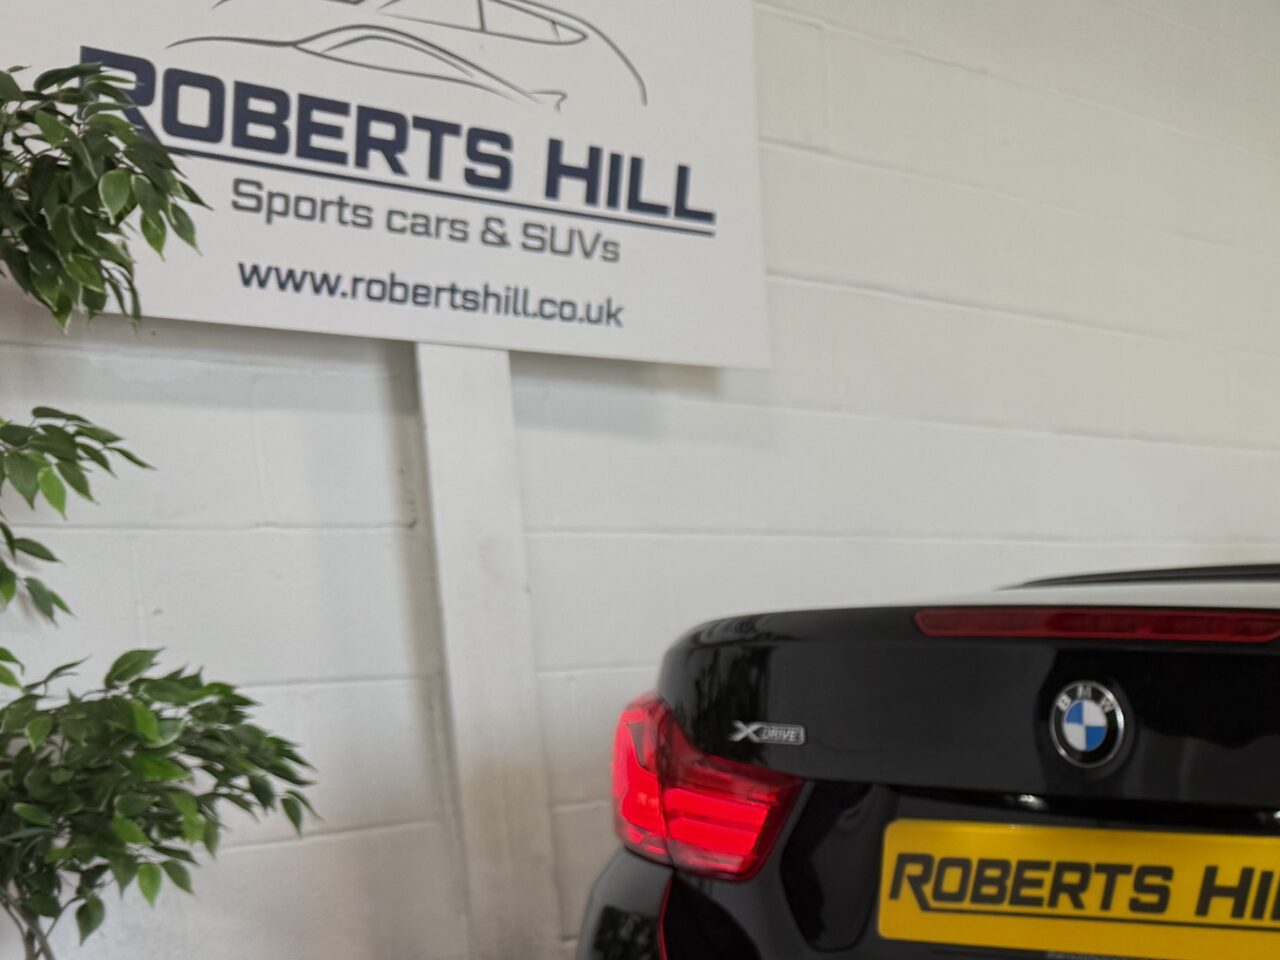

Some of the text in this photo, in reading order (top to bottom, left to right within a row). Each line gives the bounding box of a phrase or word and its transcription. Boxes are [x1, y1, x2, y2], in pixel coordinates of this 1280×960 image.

[79, 45, 716, 223] ROBERTS HILL
[231, 178, 620, 263] Sports cars & SUVs
[238, 262, 624, 328] www.robertshill.co.uk
[1055, 684, 1116, 713] BMW
[889, 853, 1175, 915] ROBERTS
